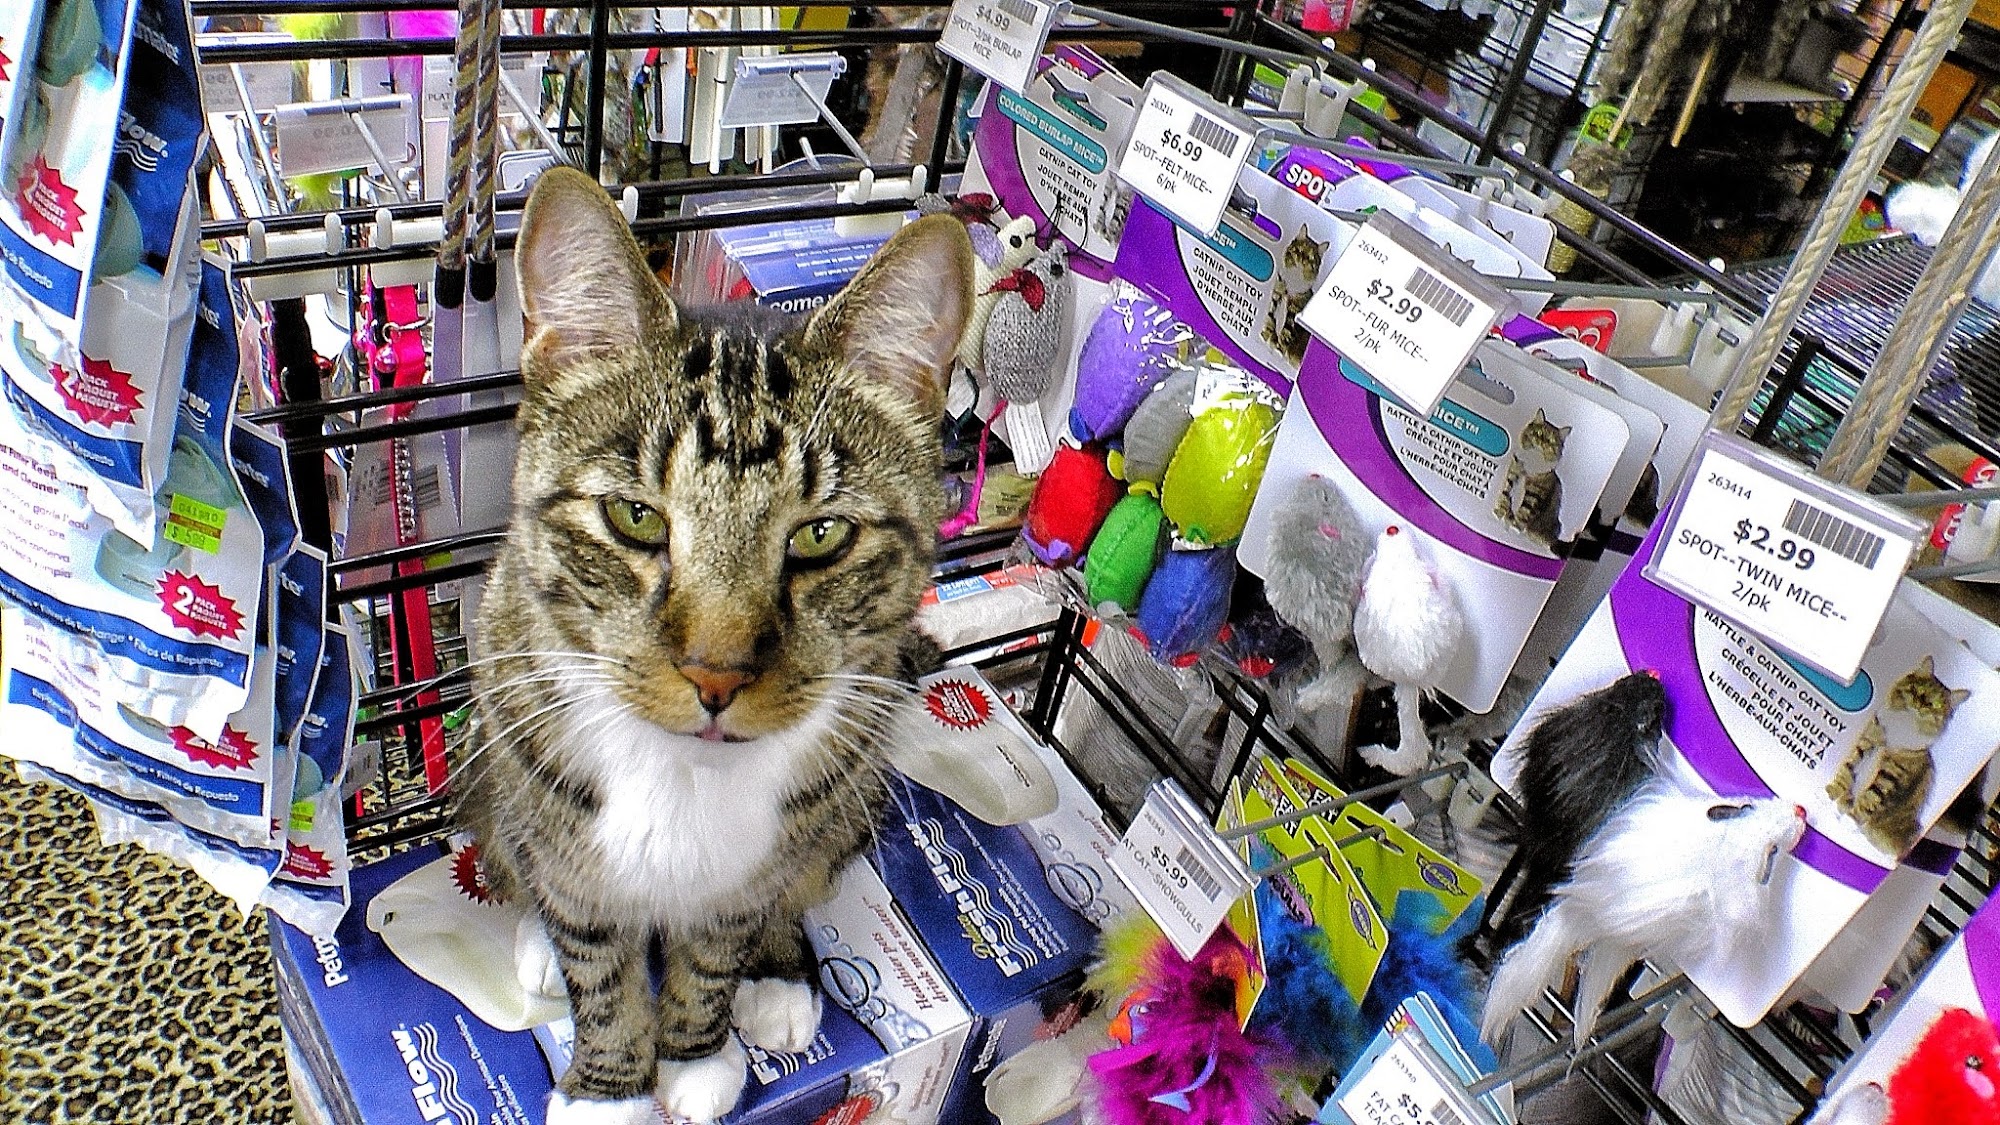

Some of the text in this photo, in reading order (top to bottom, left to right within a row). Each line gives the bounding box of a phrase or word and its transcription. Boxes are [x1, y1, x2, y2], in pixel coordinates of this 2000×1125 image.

[975, 5, 1010, 31] $4.99
[972, 41, 992, 60] MICE
[993, 36, 1022, 60] BURLAP
[1000, 95, 1038, 125] COLORED
[1038, 119, 1073, 146] BURLAP
[1160, 127, 1204, 162] $6.99
[1037, 164, 1092, 206] JOUET REMPLI
[1039, 147, 1098, 191] CATNIP CAT TOY
[1132, 139, 1214, 195] SPOT--FELT MICE--
[1155, 172, 1178, 195] 6/pk
[1286, 163, 1337, 201] SPOT
[1060, 205, 1084, 227] CHATS
[1357, 239, 1389, 265] 263412
[1193, 265, 1257, 316] JOUET REMPLI
[1194, 247, 1263, 301] CATNIP CAT TOY
[1197, 280, 1255, 327] D'HERBE AUX
[1366, 278, 1424, 323] $2.99
[1221, 311, 1250, 337] CHATS
[1328, 285, 1429, 363] SPOT--FUR MICE--
[1354, 327, 1382, 355] 2/pk
[1387, 406, 1499, 470] RATTLE & CATNIP CAT TOY
[1405, 427, 1495, 480] CRÉCELLE ET JOUET
[1399, 446, 1486, 499] L'HERBE-AUX-CHATS
[1432, 453, 1458, 472] POUR
[1459, 466, 1483, 486] CHAT
[1707, 472, 1752, 501] 263414
[1732, 517, 1816, 571] $2.99
[1677, 529, 1848, 623] SPOT--TWIN MICE--
[1730, 580, 1772, 612] 2/pk
[172, 585, 195, 616] 2
[195, 596, 217, 612] PACK
[160, 651, 174, 662] de
[1721, 648, 1835, 748] CRÉCELLE ET JOUET
[1746, 645, 1755, 657] &
[1757, 654, 1797, 690] CATNIP
[1798, 690, 1820, 713] CAT
[1823, 709, 1847, 734] TOY
[1708, 671, 1817, 770] L'HERBE-AUX-CHATS
[1751, 692, 1826, 761] POUR CHAT À
[905, 822, 963, 895] Flow
[1150, 845, 1188, 890] $5.99
[871, 932, 898, 954] pets
[898, 940, 924, 969] more
[956, 890, 1023, 978] Fresh
[889, 955, 934, 1011] Healthier
[917, 970, 949, 1003] drink
[391, 1030, 446, 1123] Flow
[1364, 1102, 1388, 1125] TEA
[1371, 1091, 1392, 1113] FAT
[1398, 1093, 1435, 1125] $5.
